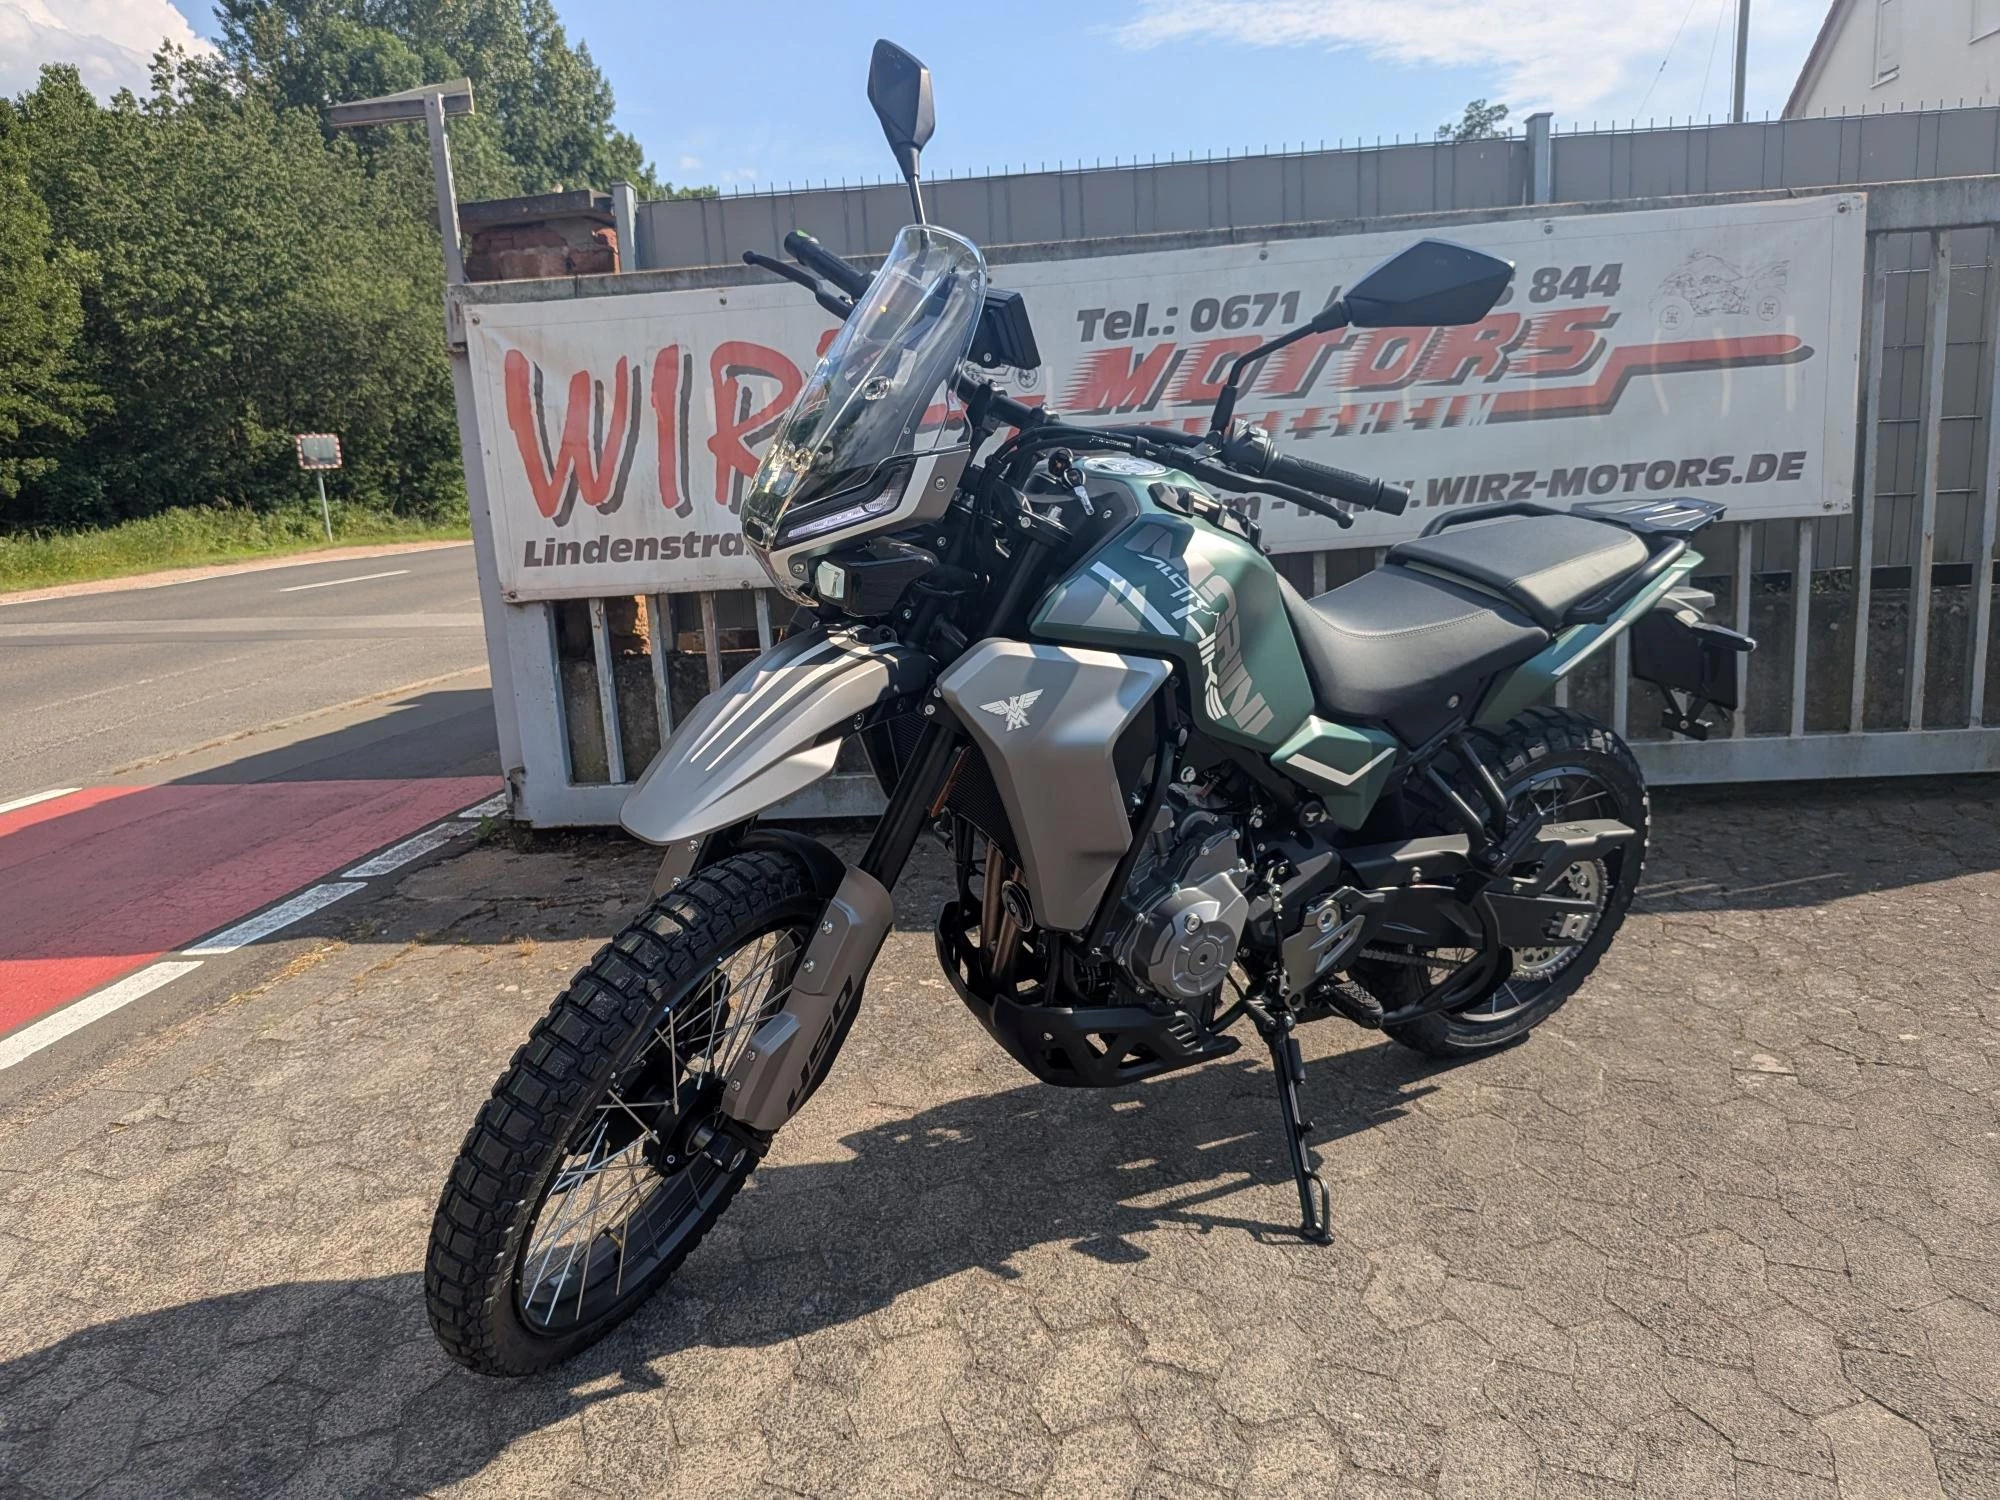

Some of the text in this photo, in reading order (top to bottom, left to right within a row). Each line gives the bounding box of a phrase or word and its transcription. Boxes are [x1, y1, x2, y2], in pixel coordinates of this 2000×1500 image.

[1076, 302, 1179, 343] Tel.:
[1189, 290, 1300, 334] 0671
[1528, 262, 1624, 304] 844
[504, 304, 1621, 527] WIR MOTORS
[1297, 450, 1808, 517] .WIRZ-MOTORS.DE
[523, 530, 751, 568] Lindenstra
